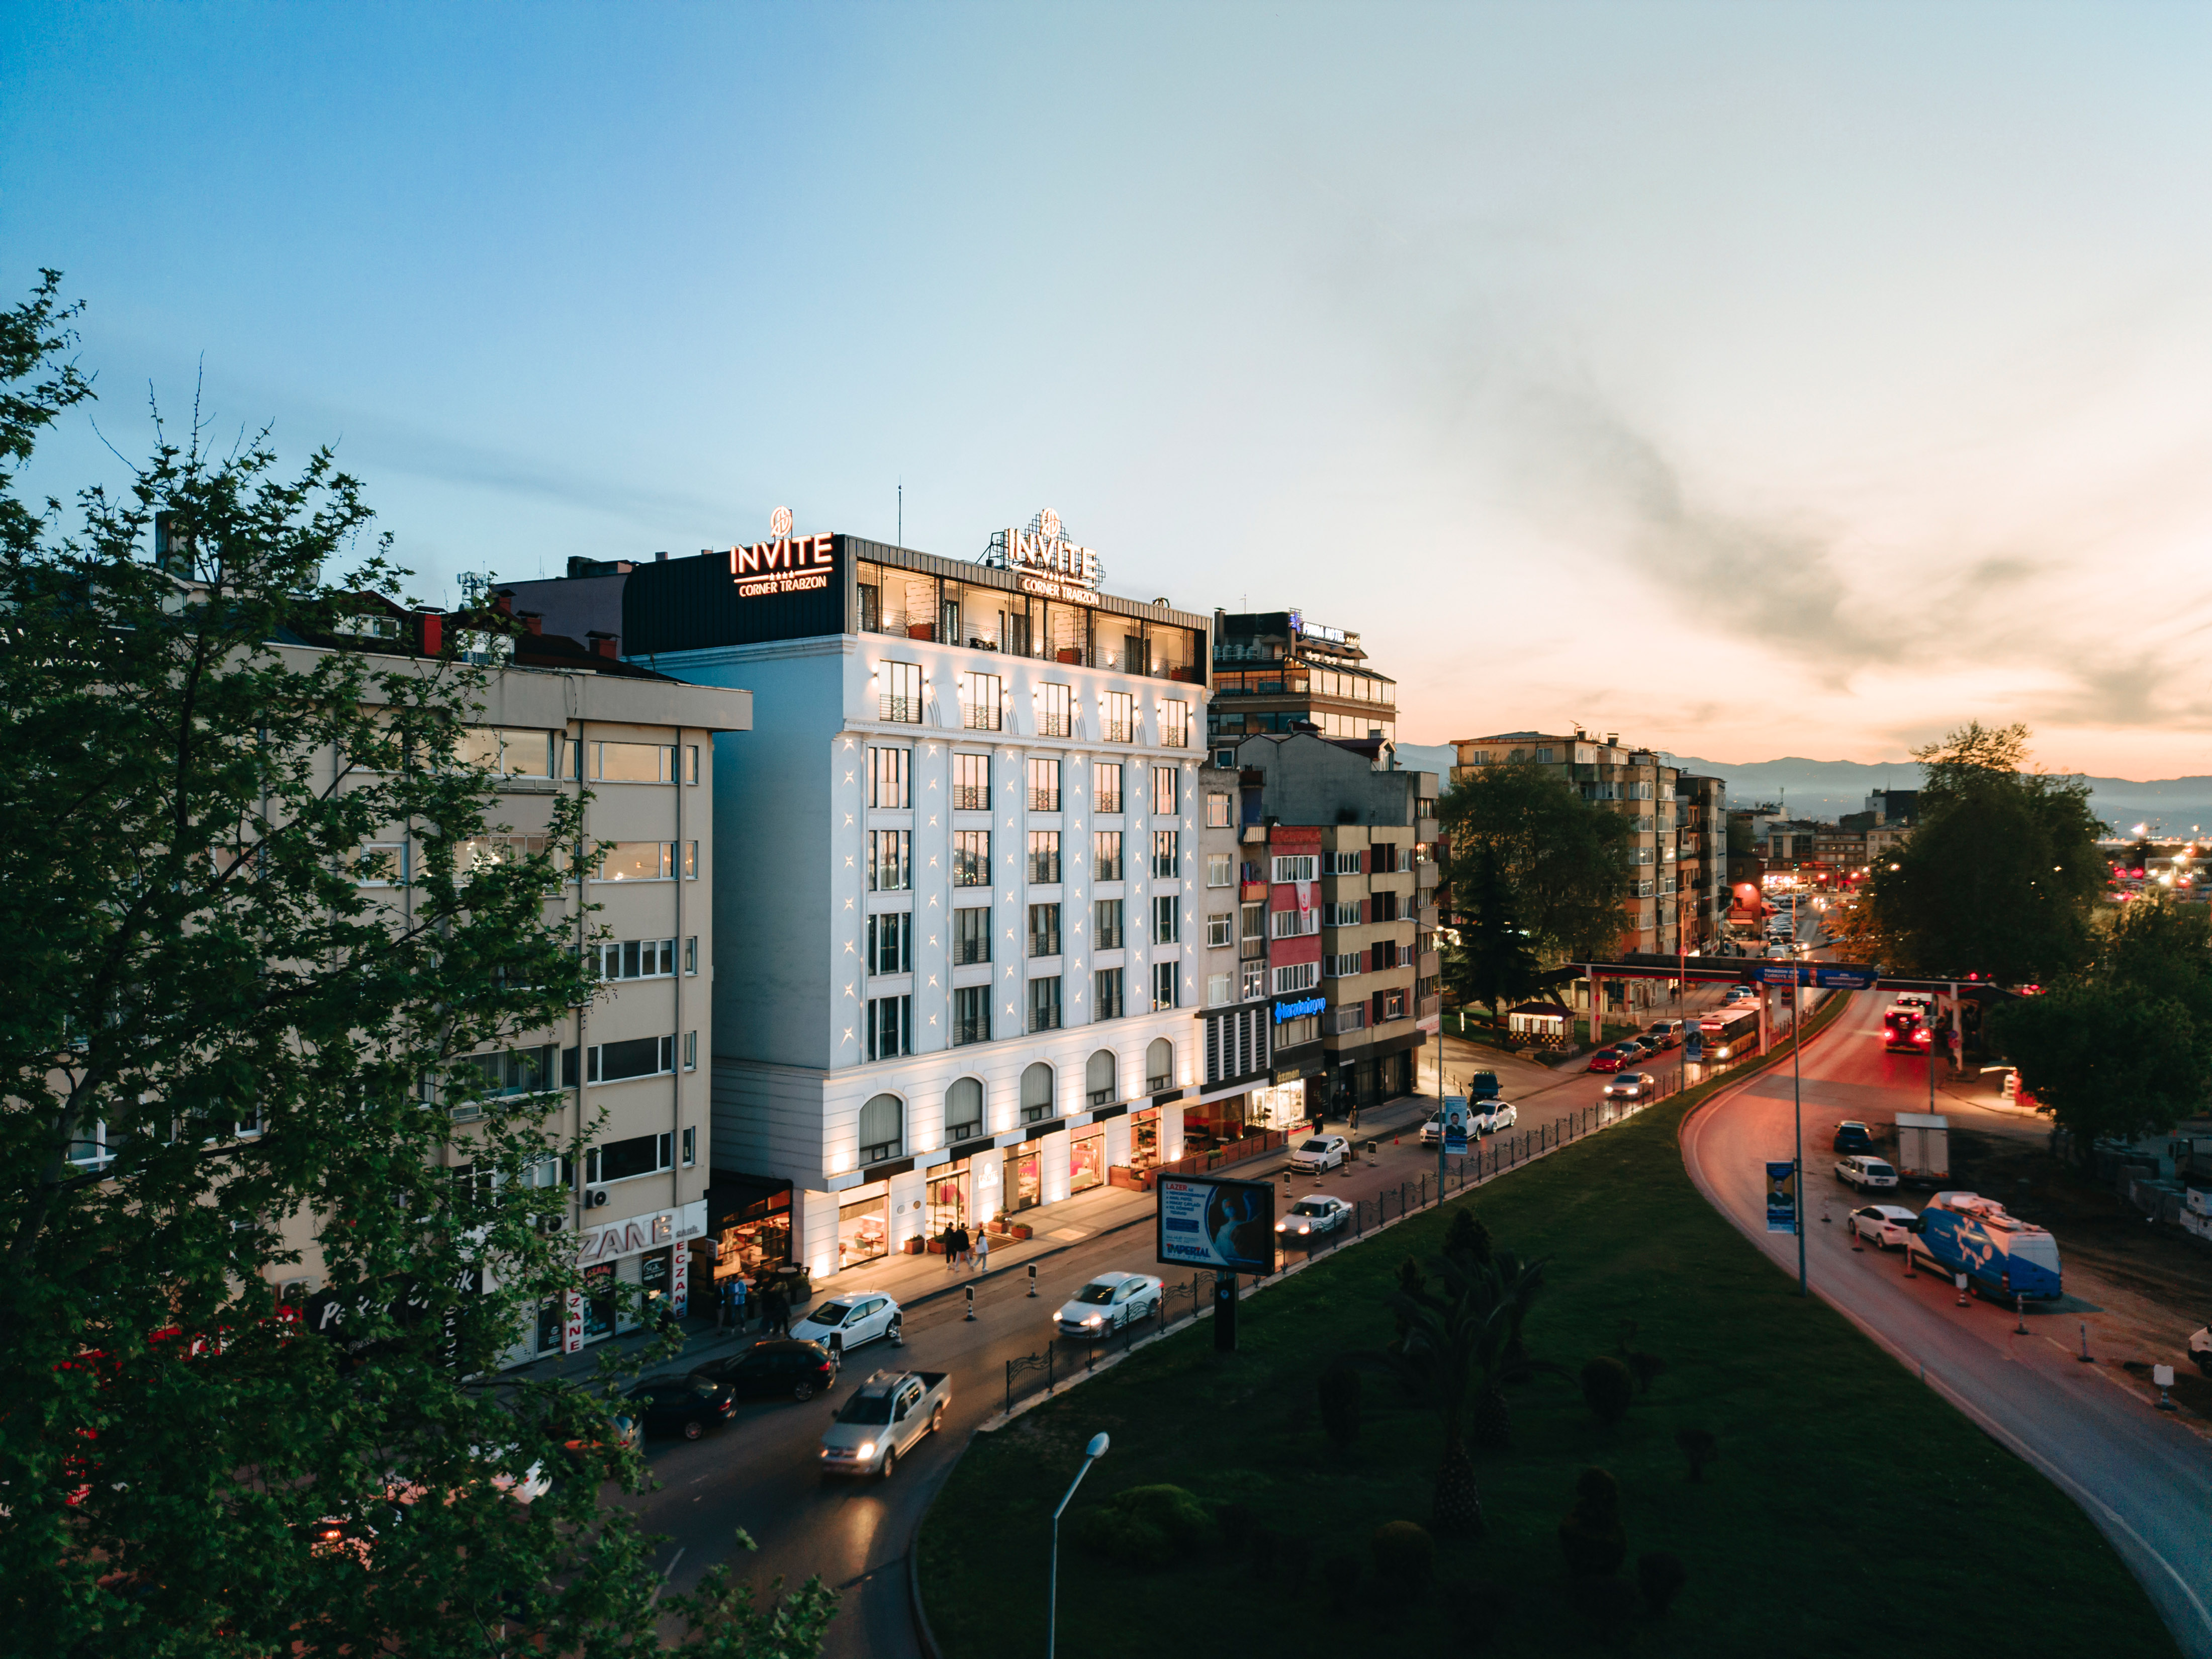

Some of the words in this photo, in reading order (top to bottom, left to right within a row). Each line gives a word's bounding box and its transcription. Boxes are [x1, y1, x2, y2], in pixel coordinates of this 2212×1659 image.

[730, 532, 833, 574] INVITE
[1008, 528, 1096, 578] INVITE
[740, 582, 777, 597] CORNER
[780, 576, 826, 591] TRABZON
[1024, 578, 1059, 597] CORNER
[1062, 587, 1099, 605] TRABZON
[1325, 627, 1345, 642] HOTEL
[675, 1241, 685, 1318] ECZANE
